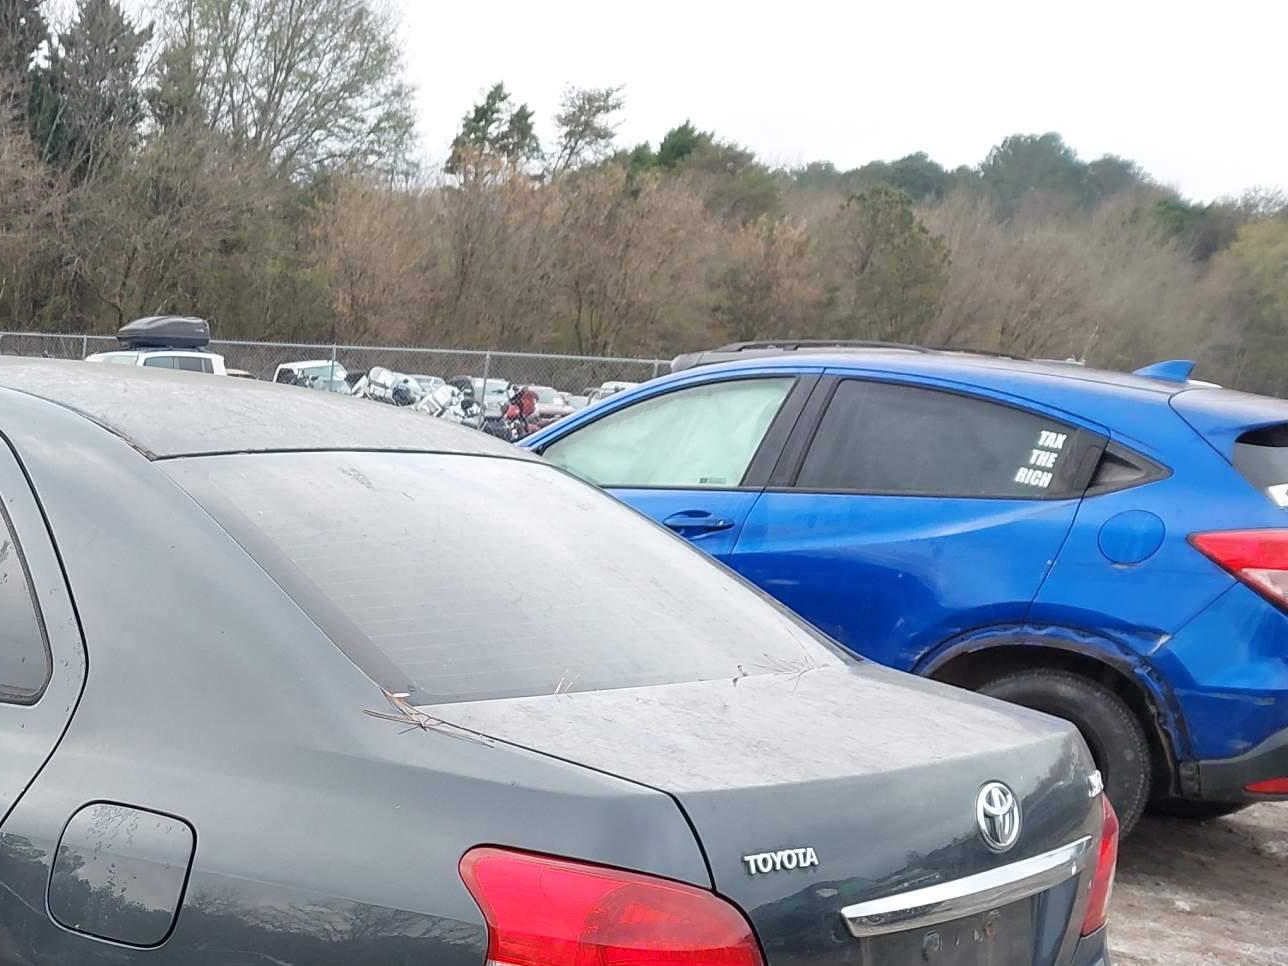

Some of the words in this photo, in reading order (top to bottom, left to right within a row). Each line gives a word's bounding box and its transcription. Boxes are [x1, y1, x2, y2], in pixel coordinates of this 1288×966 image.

[1030, 449, 1058, 468] THE
[1015, 467, 1053, 488] RICH
[743, 847, 819, 874] TOYOTA
